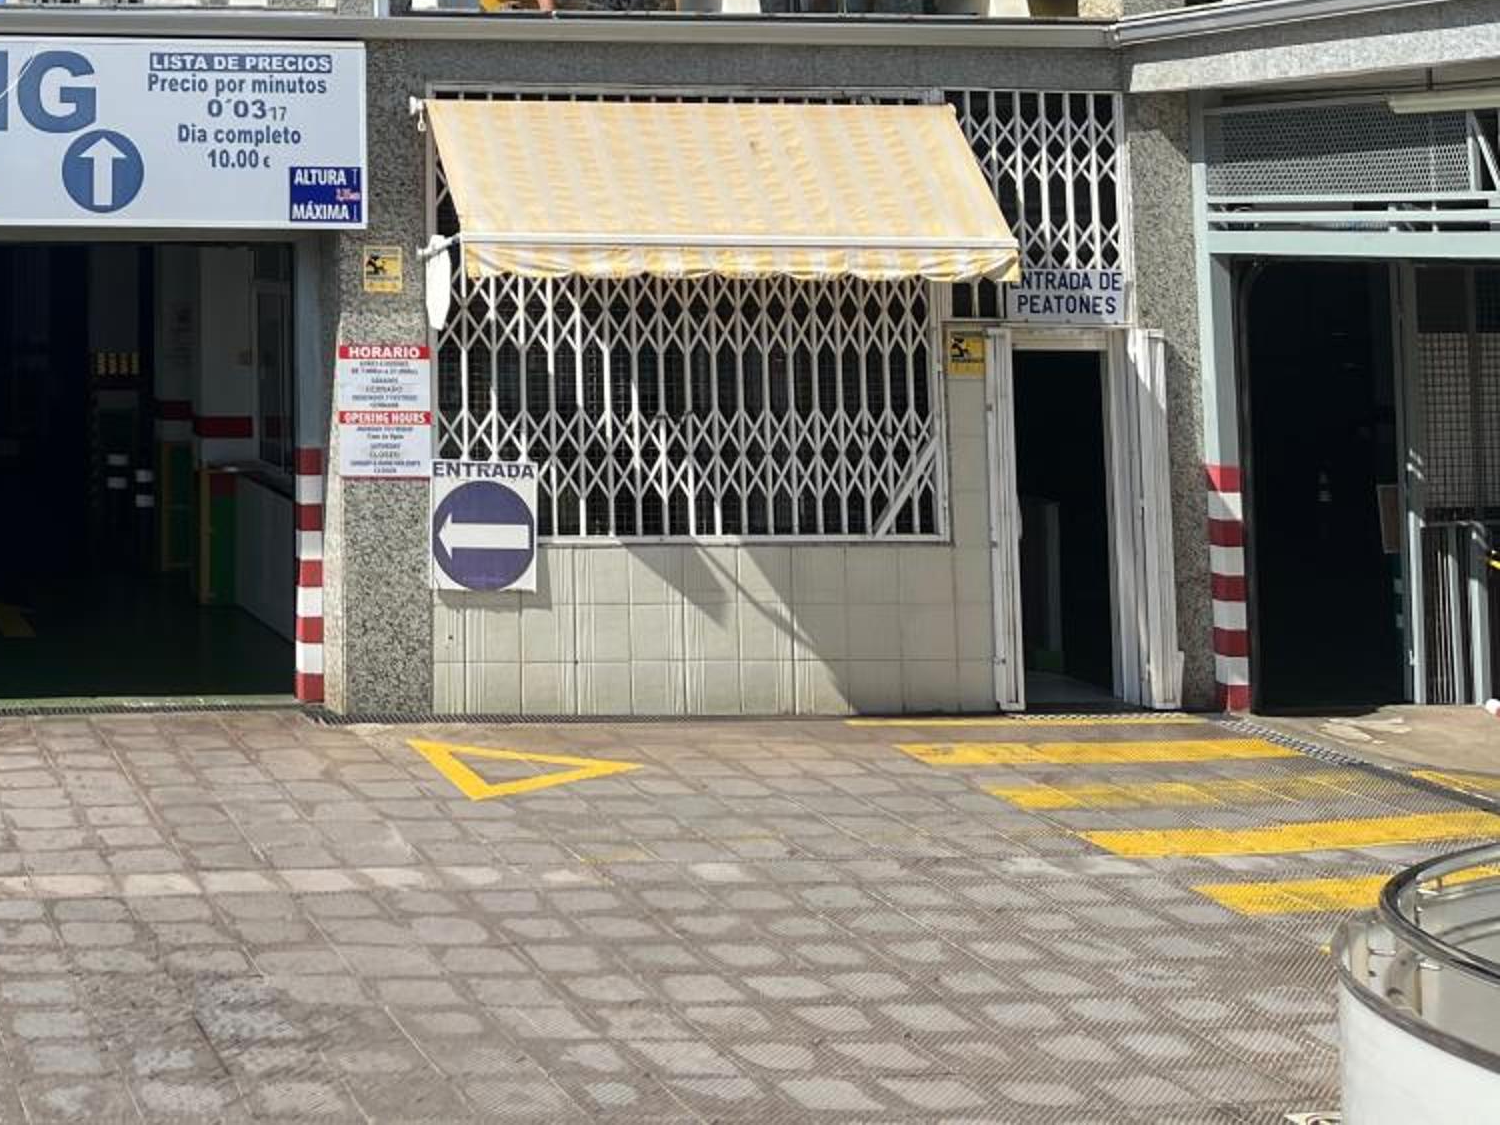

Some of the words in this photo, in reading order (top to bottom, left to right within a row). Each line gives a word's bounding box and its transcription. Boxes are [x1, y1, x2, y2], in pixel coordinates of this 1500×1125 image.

[152, 54, 207, 70] LISTA
[214, 56, 239, 70] DE
[245, 56, 331, 72] PRECIOS
[148, 73, 208, 92] Precio
[215, 79, 246, 97] por
[251, 75, 328, 94] minutos
[177, 124, 207, 143] Dia
[213, 125, 302, 147] completo
[207, 149, 259, 168] 10.00
[294, 168, 347, 186] ALTURA
[291, 200, 350, 220] MÁXIMA
[1100, 272, 1122, 291] DE
[1017, 294, 1116, 314] PEATONES
[348, 346, 420, 358] HORARIO
[344, 411, 389, 424] OPENING
[391, 411, 425, 424] HOURS
[432, 461, 534, 478] ENTRADA
